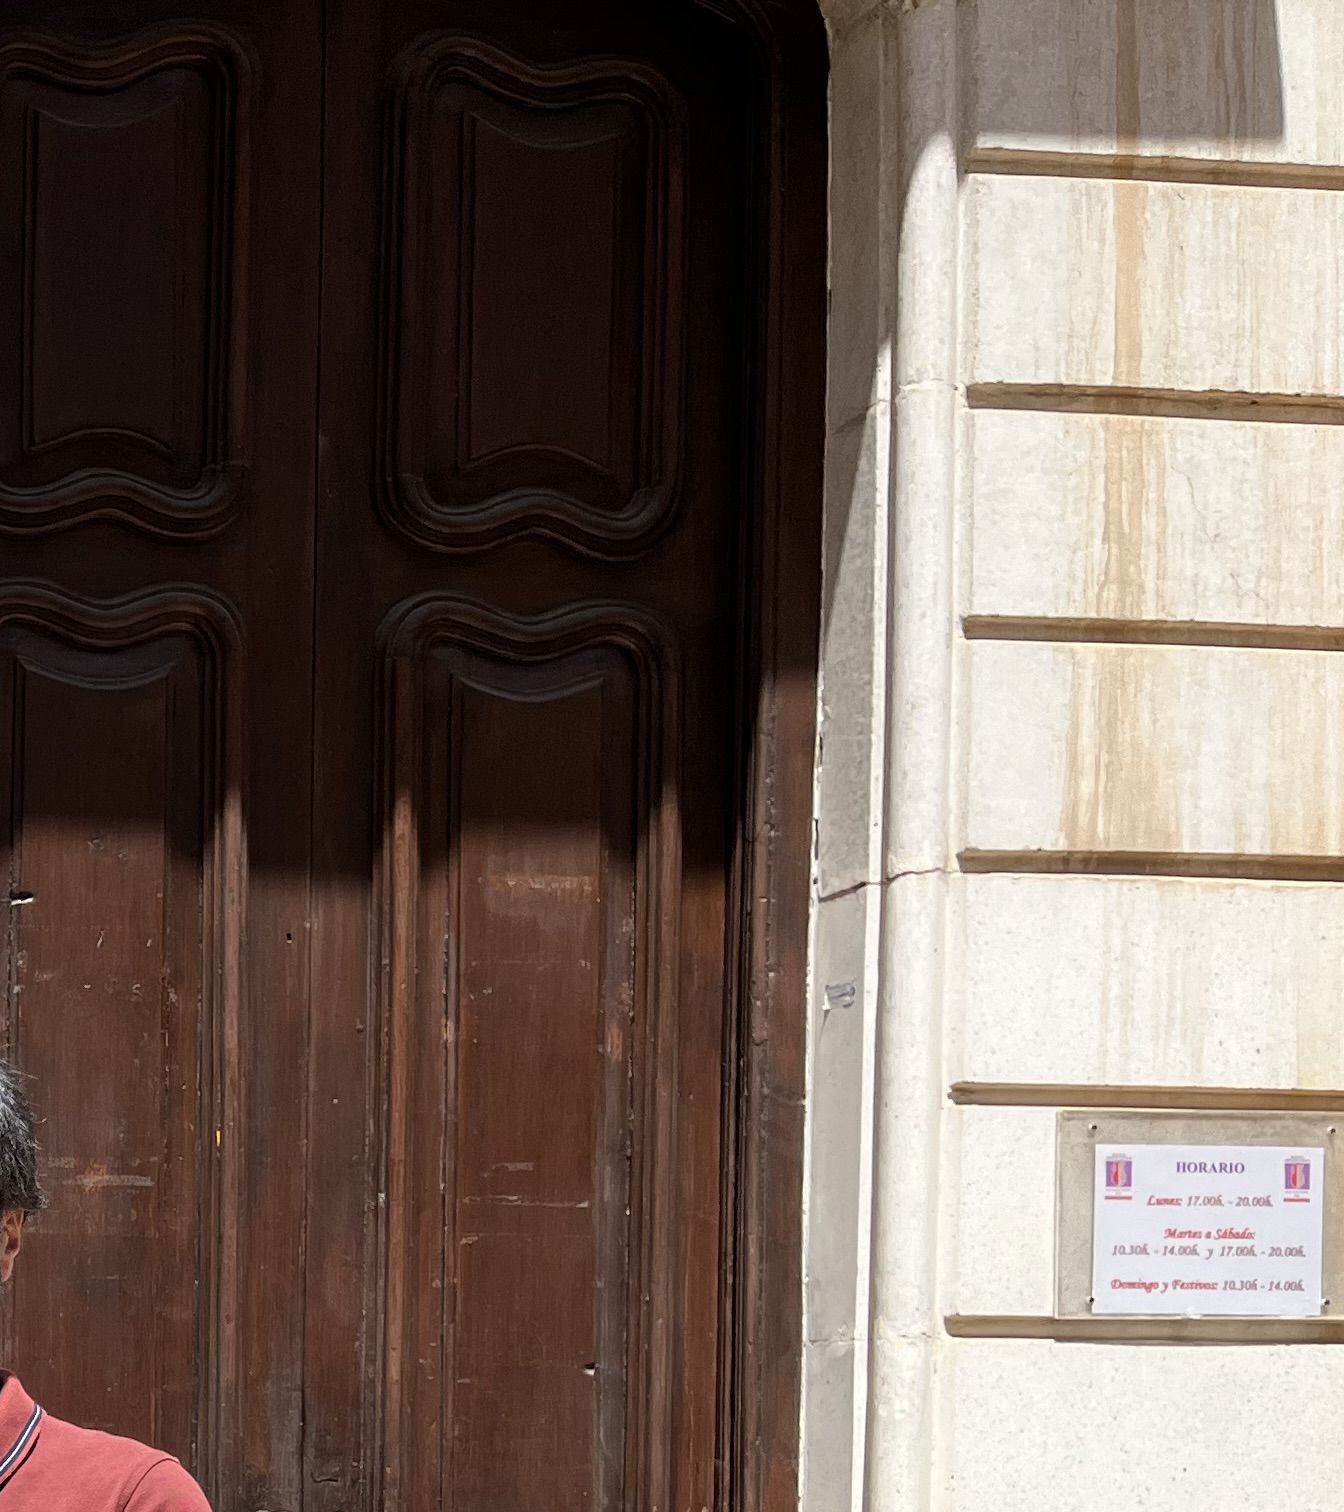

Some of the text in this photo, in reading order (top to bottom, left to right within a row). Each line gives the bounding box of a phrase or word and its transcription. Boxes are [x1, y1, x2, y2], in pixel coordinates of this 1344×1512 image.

[1176, 1161, 1245, 1174] HORARIO
[1163, 1228, 1202, 1239] Martes
[1204, 1231, 1212, 1239] a
[1204, 1247, 1214, 1260] y
[1111, 1278, 1159, 1293] Domingo
[1160, 1281, 1169, 1293] y
